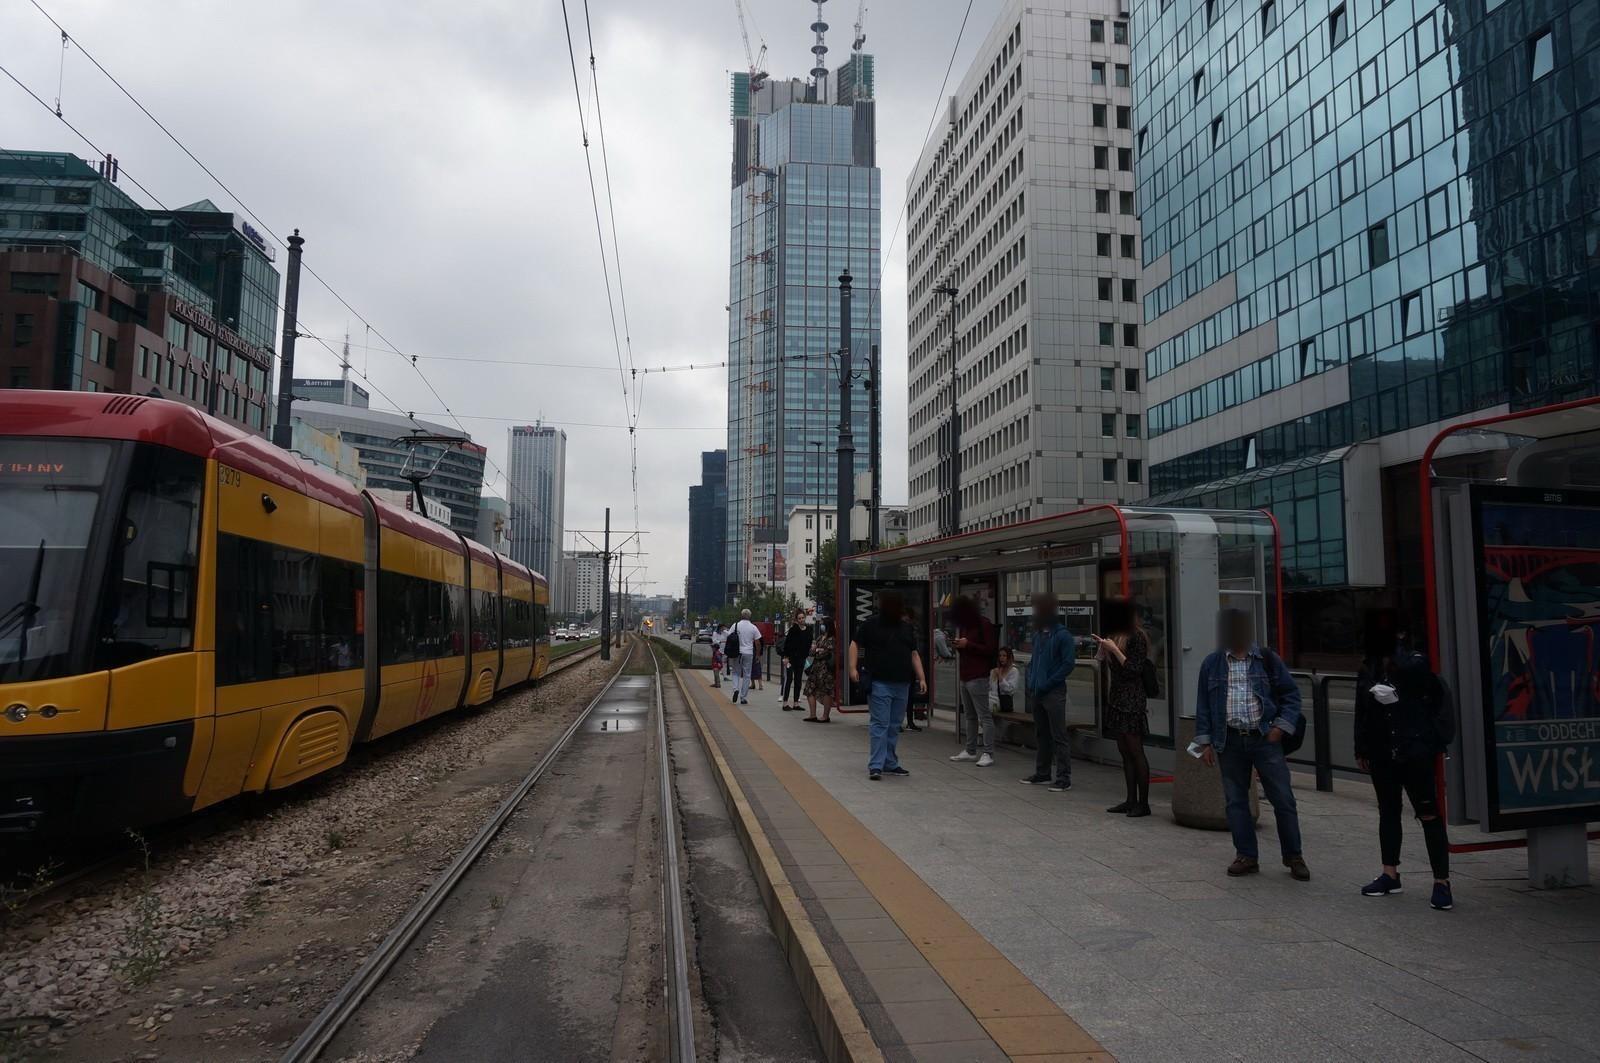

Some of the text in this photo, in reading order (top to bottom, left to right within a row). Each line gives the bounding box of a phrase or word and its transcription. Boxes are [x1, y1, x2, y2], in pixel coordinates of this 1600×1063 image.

[167, 341, 267, 409] KASKADA
[1537, 721, 1596, 741] ODDECH
[1506, 746, 1600, 796] WISŁ
